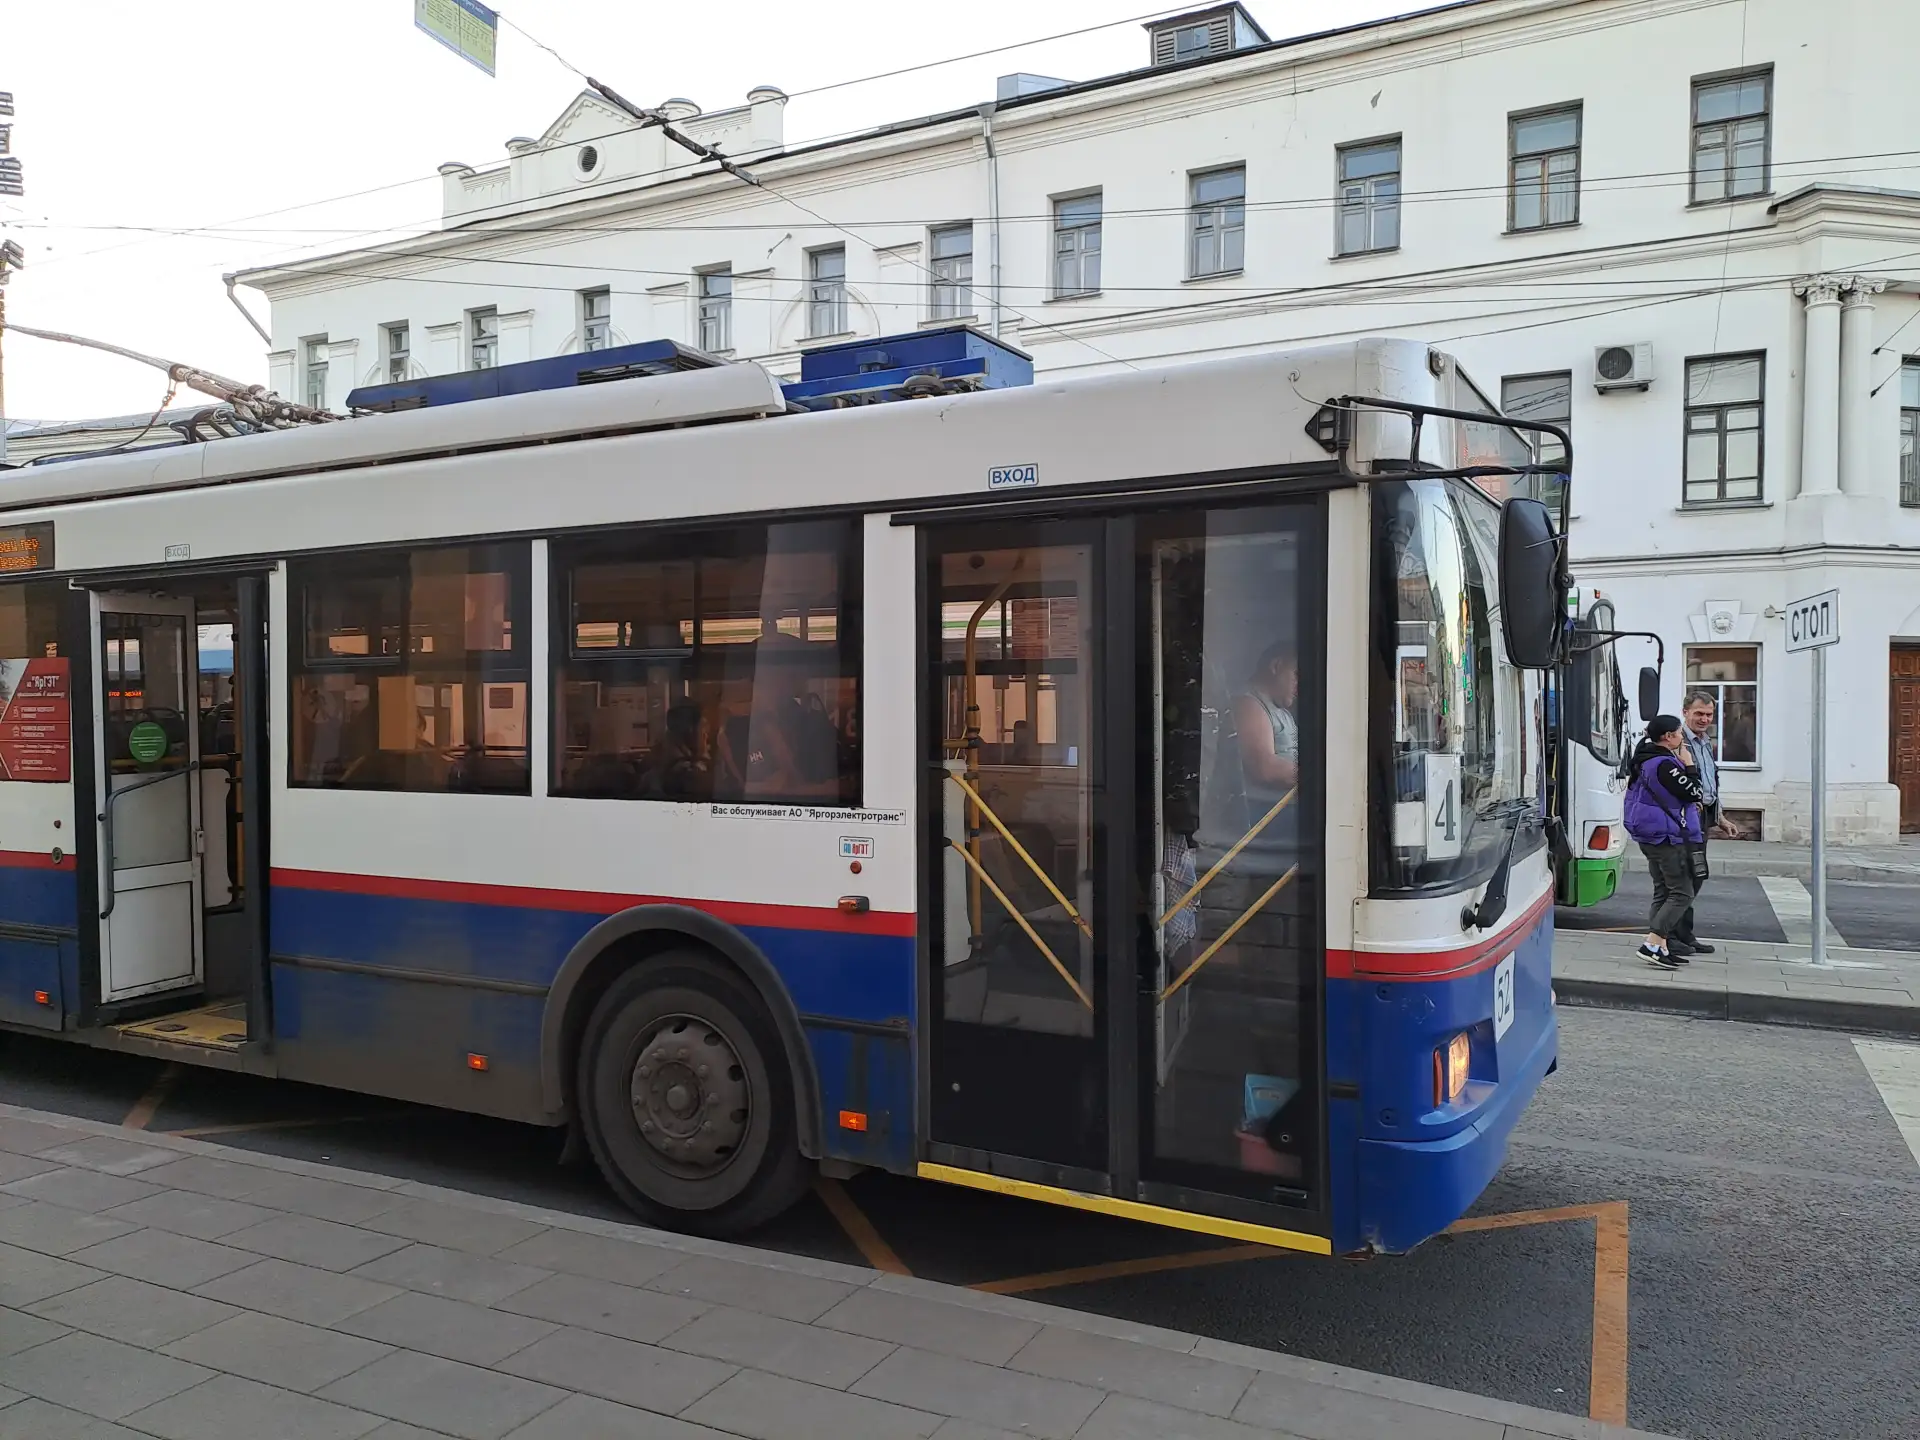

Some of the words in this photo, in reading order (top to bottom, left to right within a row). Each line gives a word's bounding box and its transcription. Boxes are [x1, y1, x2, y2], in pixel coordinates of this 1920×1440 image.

[992, 467, 1035, 484] ВХОД
[166, 546, 189, 558] ВХОД
[1791, 601, 1829, 643] СТОП
[712, 805, 728, 815] Вас
[729, 806, 787, 817] обслуживает
[788, 808, 803, 817] АО
[804, 808, 904, 823] "Яргорэлектротранс"
[1435, 779, 1457, 842] 4
[1498, 969, 1510, 1024] 52
